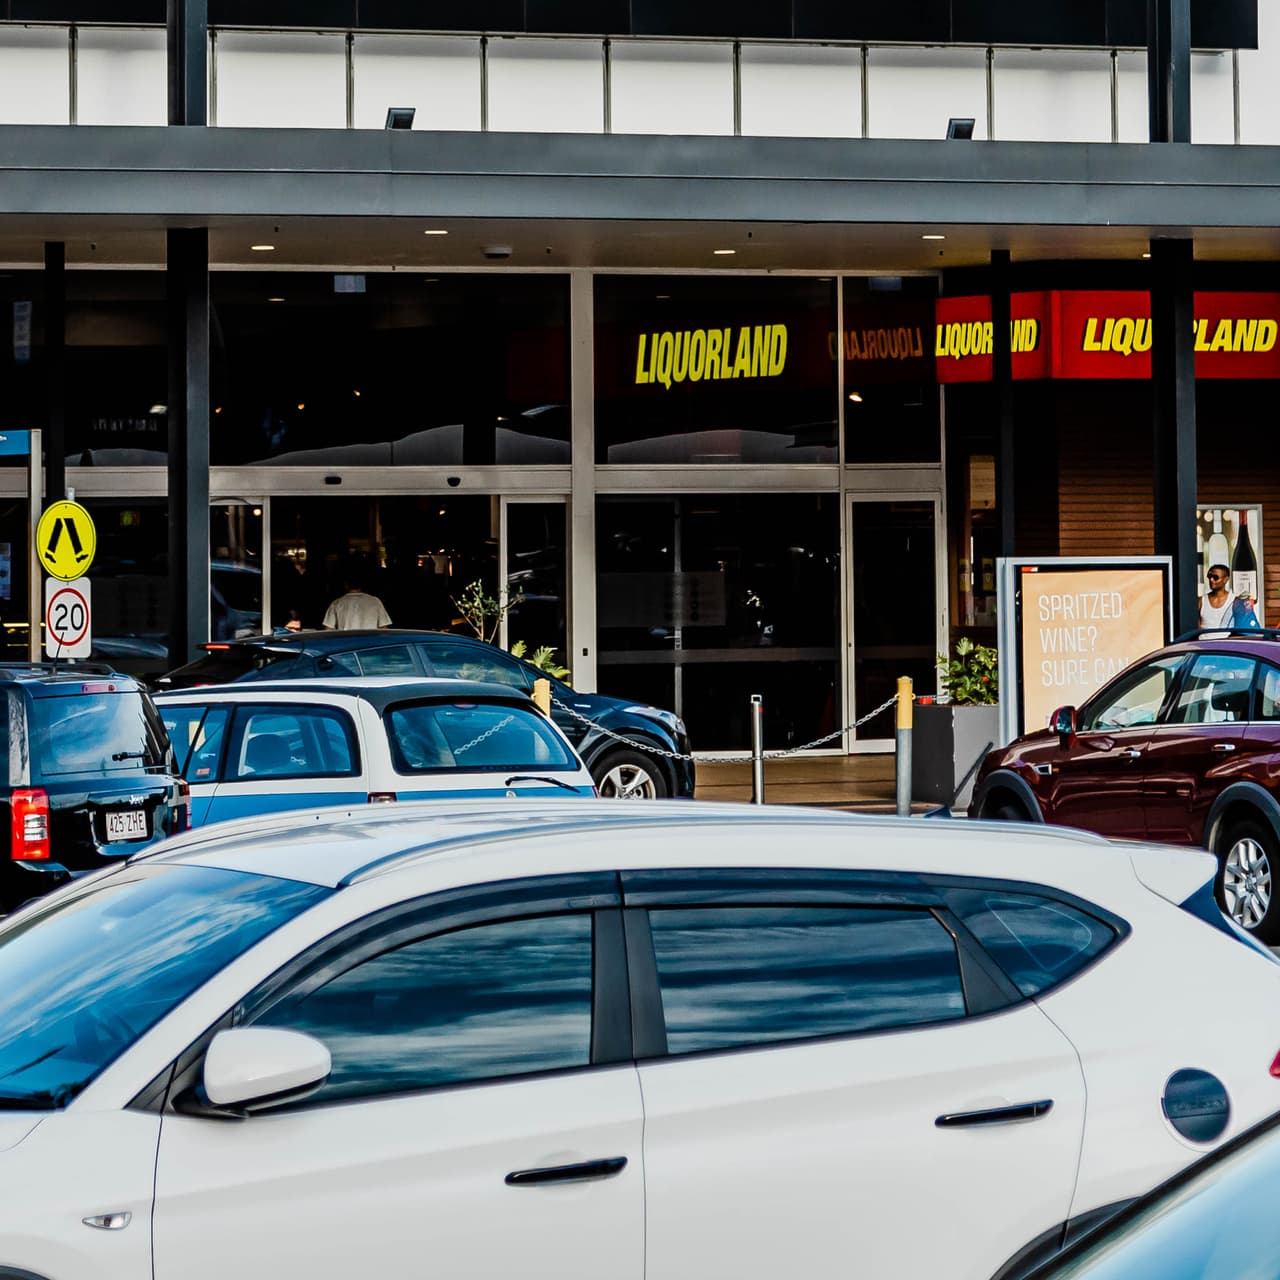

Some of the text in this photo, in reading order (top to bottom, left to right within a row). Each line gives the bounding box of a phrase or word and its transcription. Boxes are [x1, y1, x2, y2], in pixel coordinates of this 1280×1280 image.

[935, 319, 1038, 360] LIQUORND
[1083, 317, 1278, 356] LIQULAND
[635, 324, 788, 390] LIQUORLAND
[55, 603, 85, 631] 20
[1038, 591, 1123, 622] SPRITZED
[1039, 625, 1098, 654] WINE?
[1041, 659, 1089, 688] SURE
[109, 812, 145, 832] 425 ZHE
